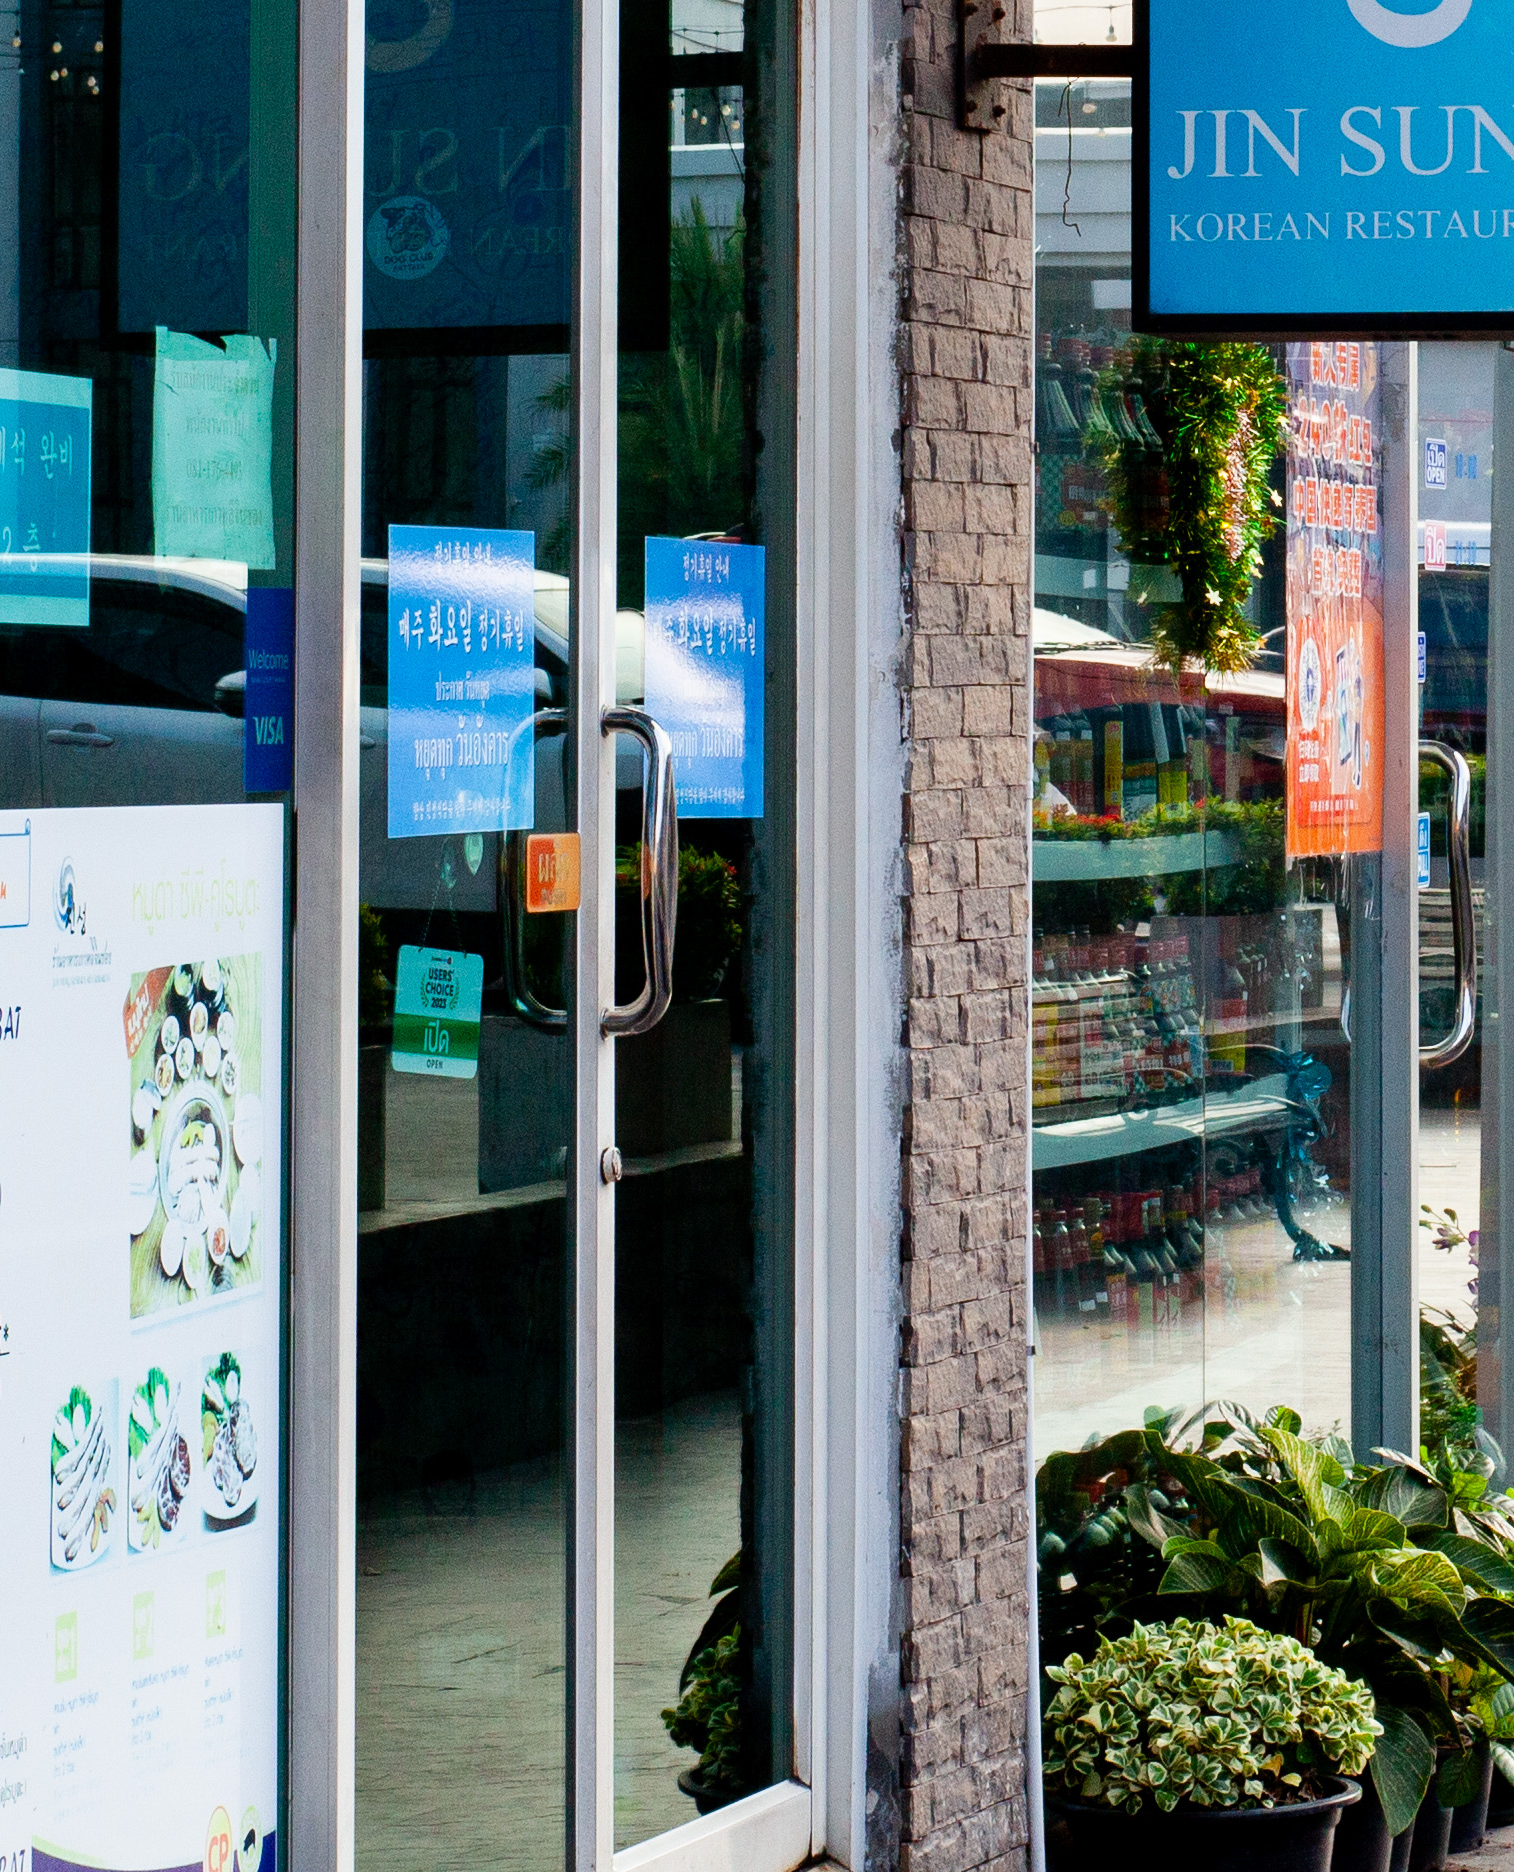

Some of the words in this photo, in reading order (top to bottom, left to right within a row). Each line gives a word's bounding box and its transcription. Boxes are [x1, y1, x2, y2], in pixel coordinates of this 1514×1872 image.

[1167, 108, 1309, 180] JIN
[1169, 211, 1332, 242] KOREAN
[1427, 466, 1445, 484] OPEN
[399, 608, 424, 651] 매주
[428, 599, 472, 653] 화요일
[477, 609, 523, 652] 정기휴일
[248, 649, 289, 670] Welcome
[253, 716, 284, 745] VISA
[456, 714, 510, 767] วันอังคาร
[428, 967, 455, 980] USERS'
[425, 981, 454, 997] CHOICE
[431, 997, 447, 1009] 2023
[424, 1019, 450, 1055] เปิด
[426, 1059, 444, 1070] OPEN
